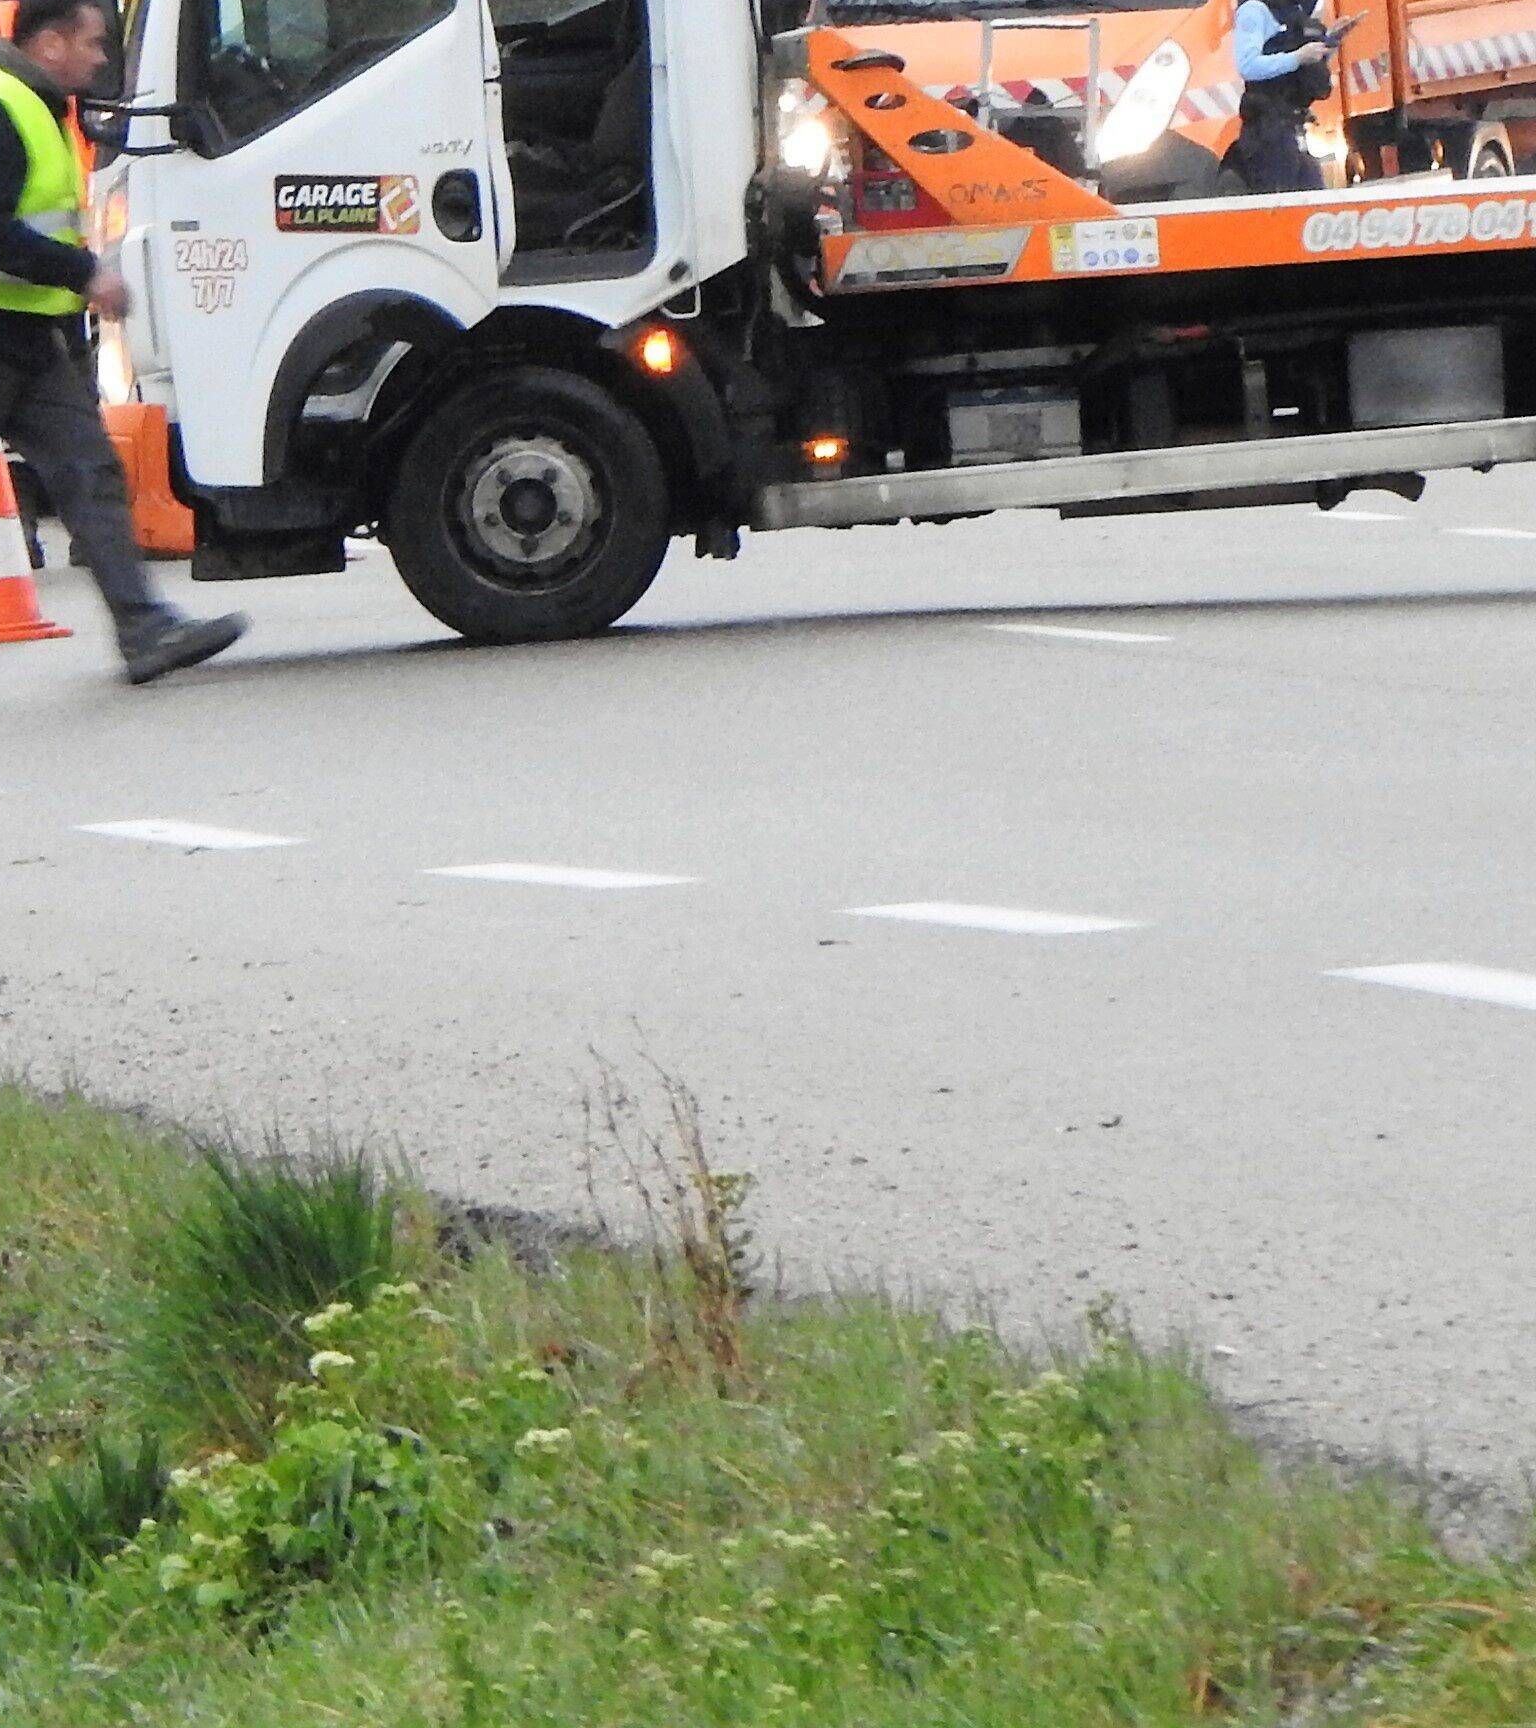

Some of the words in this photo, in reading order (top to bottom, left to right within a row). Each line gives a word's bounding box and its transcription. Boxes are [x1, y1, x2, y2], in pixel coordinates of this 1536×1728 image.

[278, 182, 378, 208] GARAGE
[294, 209, 314, 225] LA
[317, 207, 377, 225] PLAINE
[1304, 212, 1358, 251] 04
[1361, 209, 1413, 247] 94
[1472, 201, 1524, 240] 04
[175, 239, 248, 271] 24h/24
